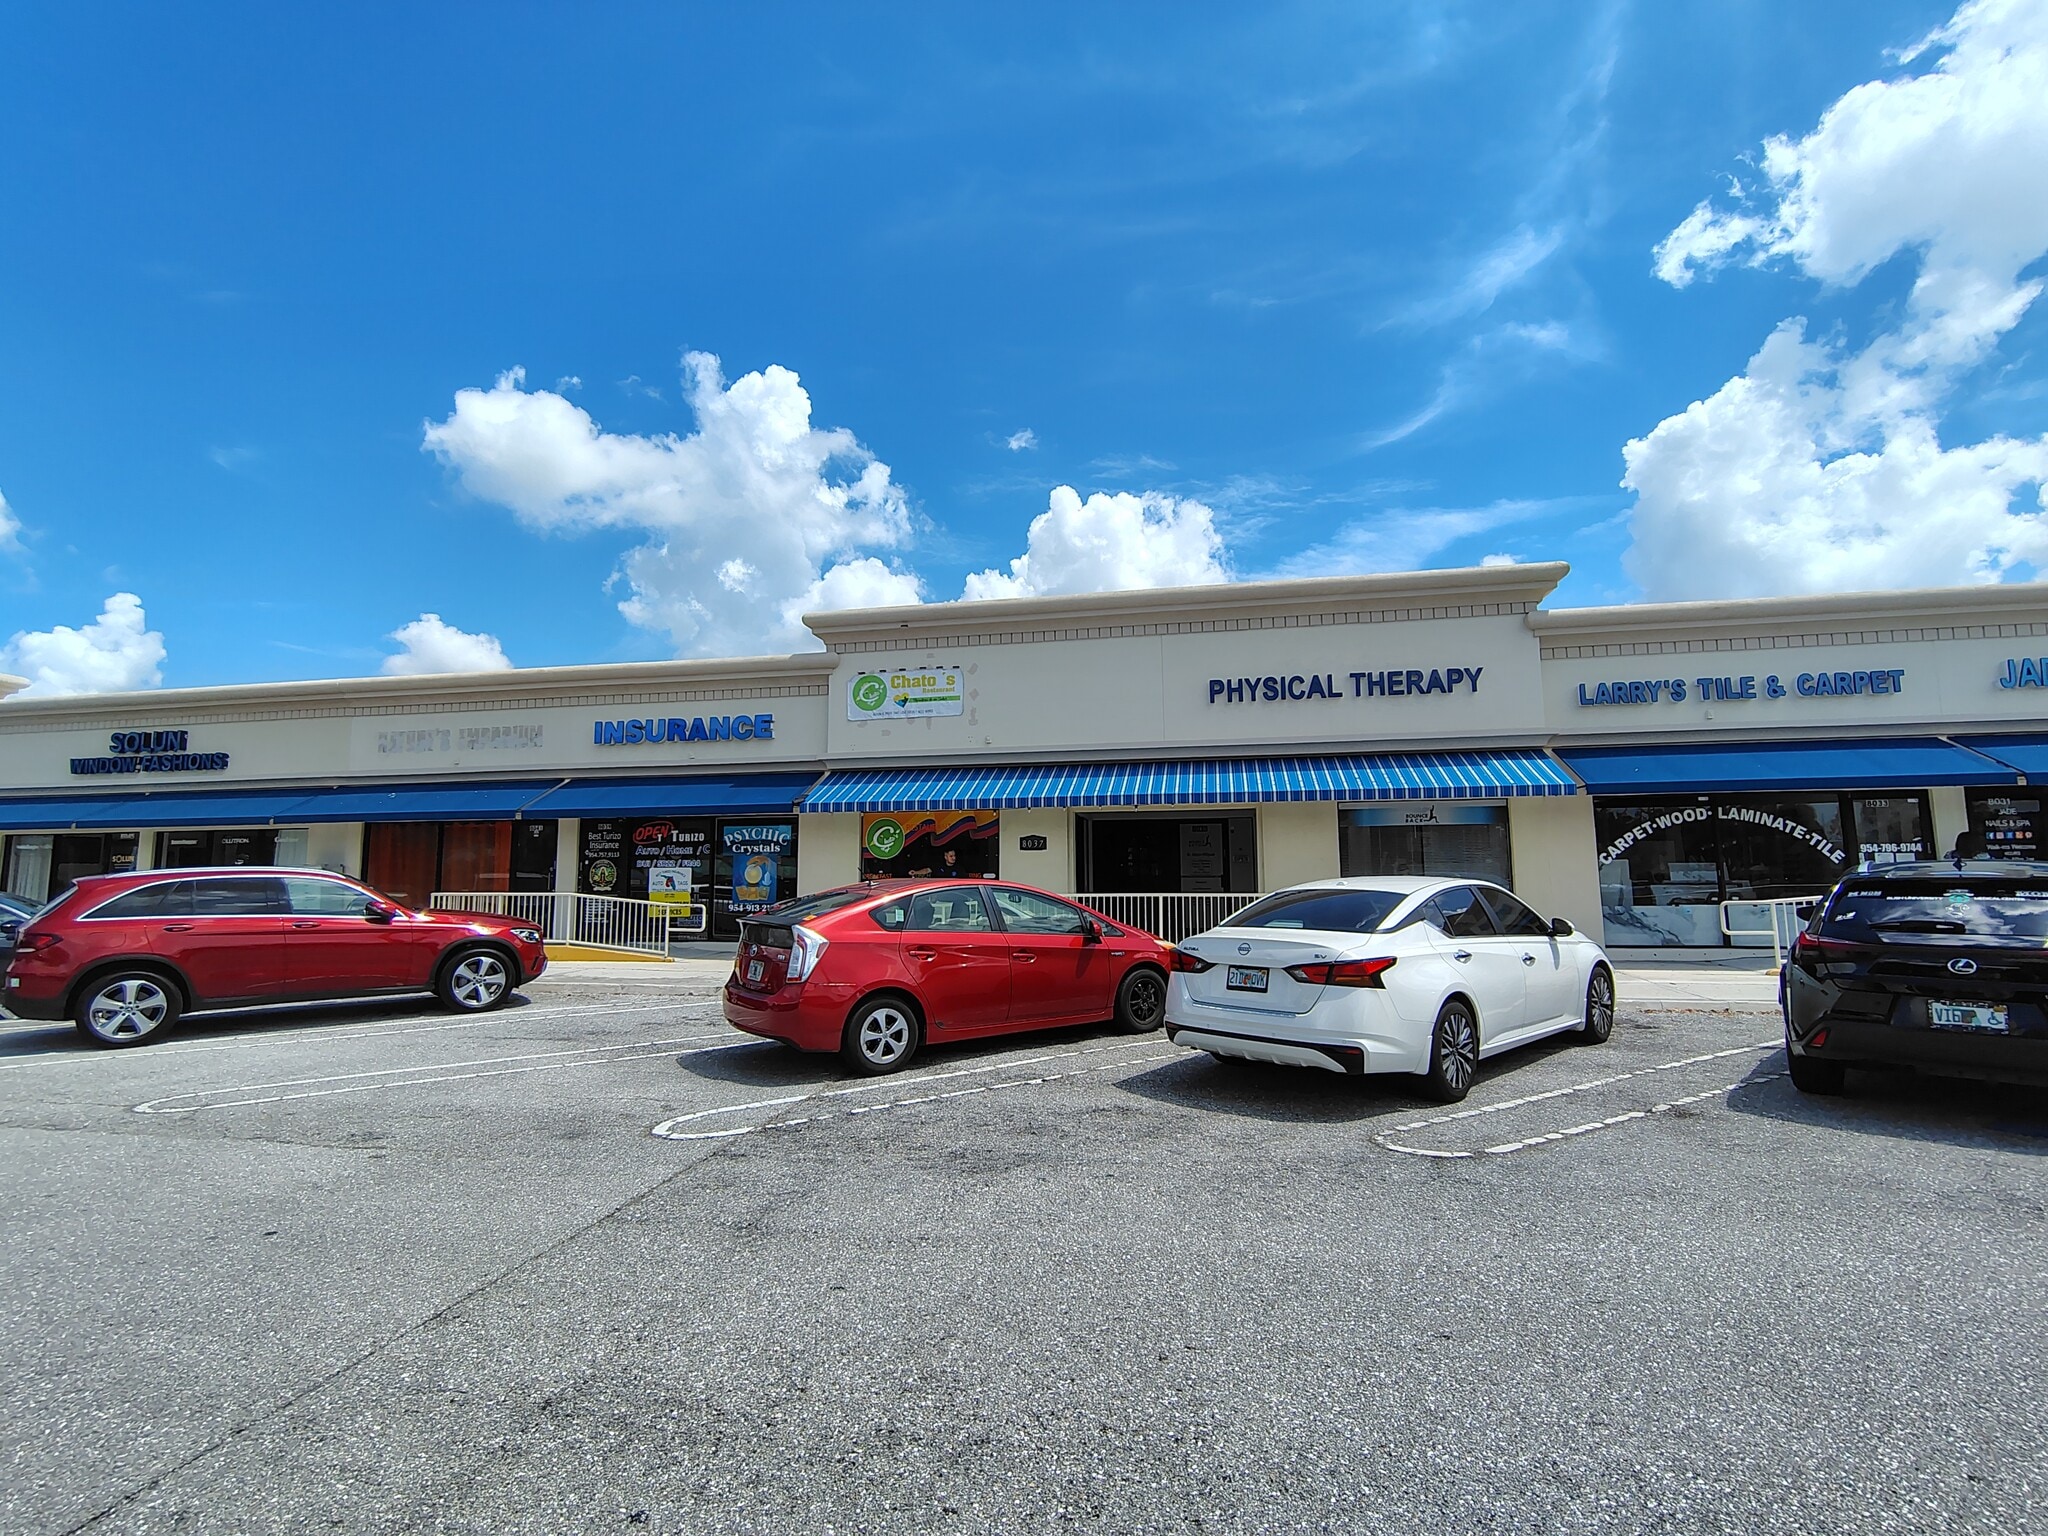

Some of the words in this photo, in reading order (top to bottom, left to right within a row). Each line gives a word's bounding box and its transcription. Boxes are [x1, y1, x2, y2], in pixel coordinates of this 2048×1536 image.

[1209, 674, 1343, 703] PHYSICAL
[1350, 667, 1484, 697] THERAPY
[1579, 679, 1686, 706] LARRY'S
[1697, 676, 1756, 701] TILE
[1766, 674, 1787, 699] &
[1797, 669, 1905, 697] CARPET
[593, 714, 775, 745] INSURANCE
[109, 730, 188, 754] SOLUN
[70, 756, 140, 775] WINDOW
[141, 752, 229, 773] FASHIONS
[588, 832, 602, 840] Best
[603, 832, 622, 840] Turizo
[635, 824, 670, 841] OPEN
[724, 827, 790, 847] PSYCHIC
[589, 841, 620, 849] Insurance
[666, 844, 693, 855] HOME
[732, 843, 781, 855] Crystals
[1022, 840, 1044, 848] 8037
[1808, 832, 1846, 864] TILE
[1860, 842, 1922, 853] 954-796-9744
[112, 855, 135, 863] SOLUN
